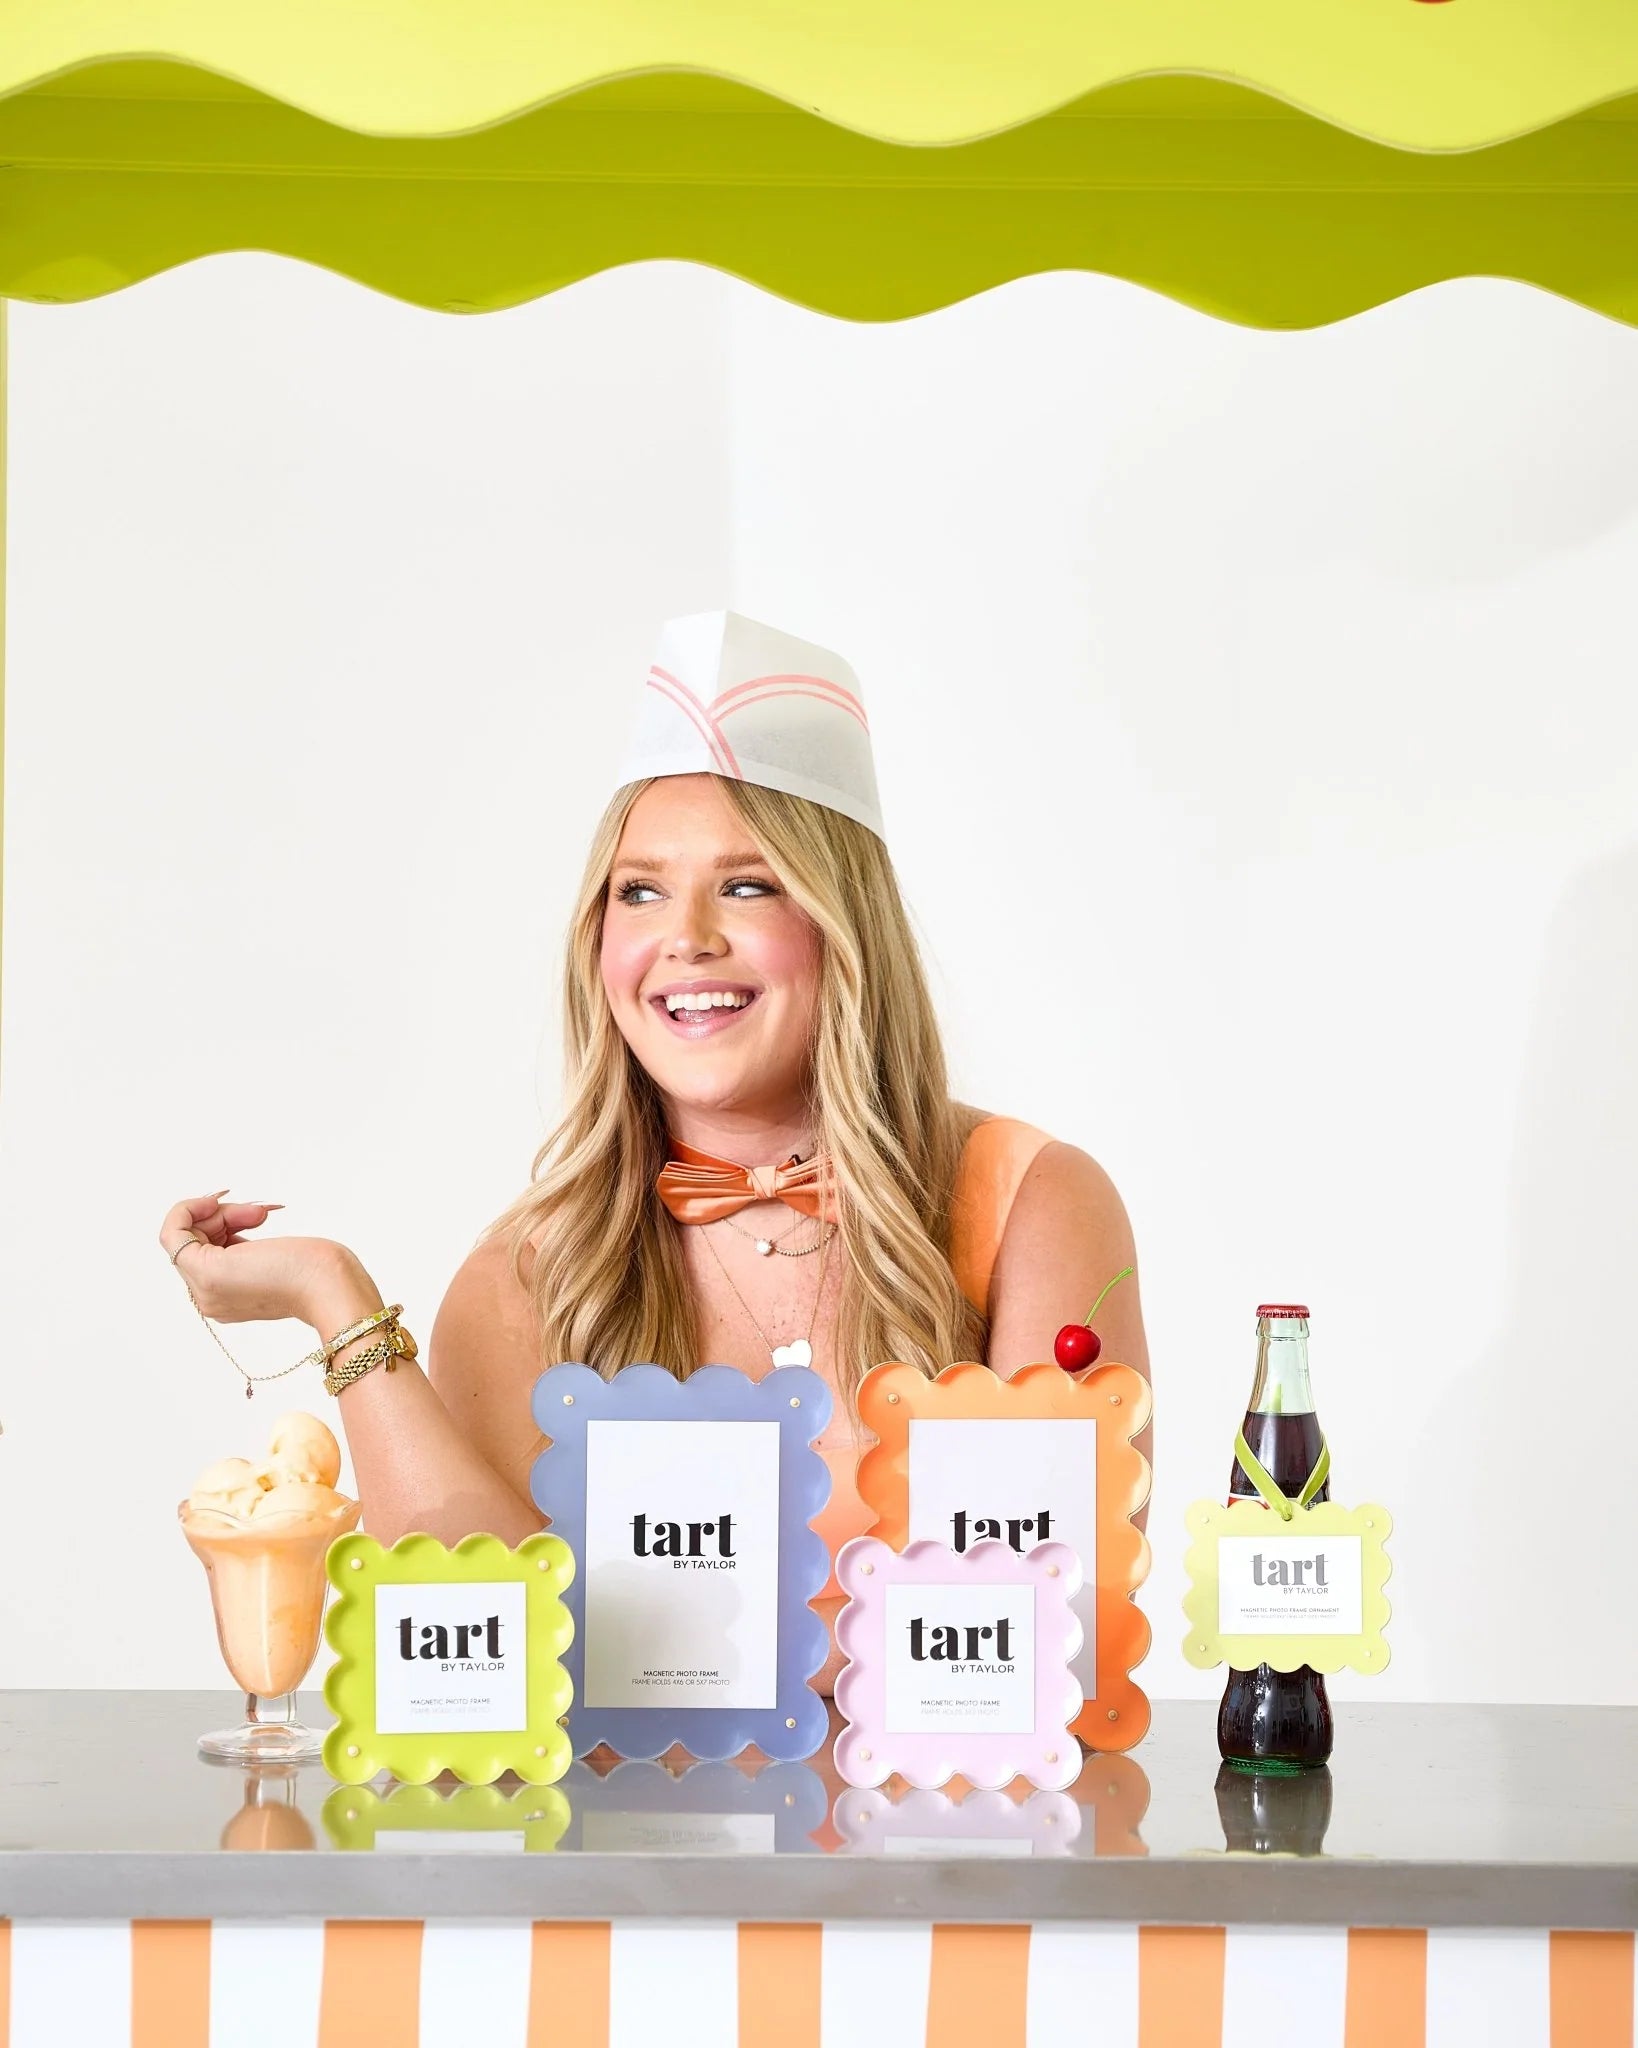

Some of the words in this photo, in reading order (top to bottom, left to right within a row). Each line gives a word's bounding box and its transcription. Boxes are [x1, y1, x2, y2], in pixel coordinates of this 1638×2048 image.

[629, 1513, 737, 1558] tart
[673, 1560, 689, 1569] BY
[691, 1560, 736, 1570] TAYLOR
[1249, 1553, 1328, 1586] tart
[1283, 1587, 1294, 1595] BY
[1296, 1587, 1329, 1595] TAYLOR
[395, 1615, 505, 1660] tart
[906, 1617, 1015, 1661] tart
[441, 1663, 456, 1672] BY
[460, 1662, 505, 1671] TAYLOR
[951, 1664, 966, 1674] BY
[969, 1664, 1015, 1674] TAYLOR
